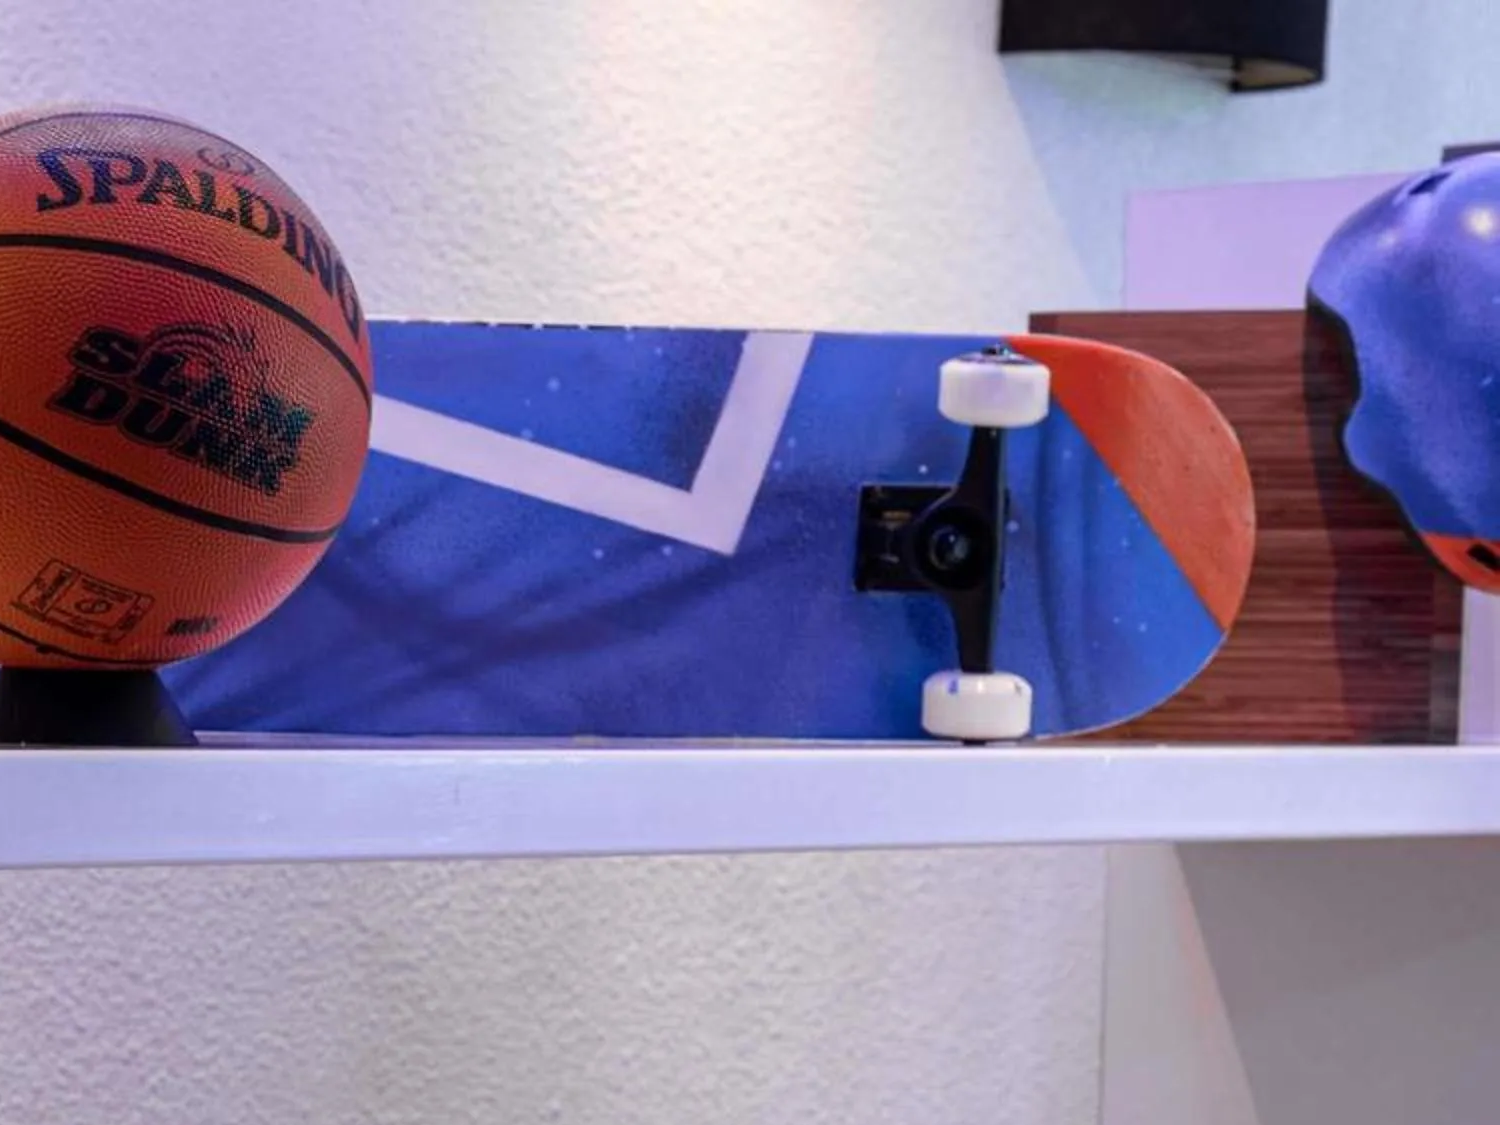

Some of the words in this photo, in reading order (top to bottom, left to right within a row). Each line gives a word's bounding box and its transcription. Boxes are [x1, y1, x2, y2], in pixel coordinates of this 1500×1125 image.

[36, 146, 360, 344] SPALDING
[45, 368, 300, 498] DUNK
[66, 322, 316, 454] SLAM
